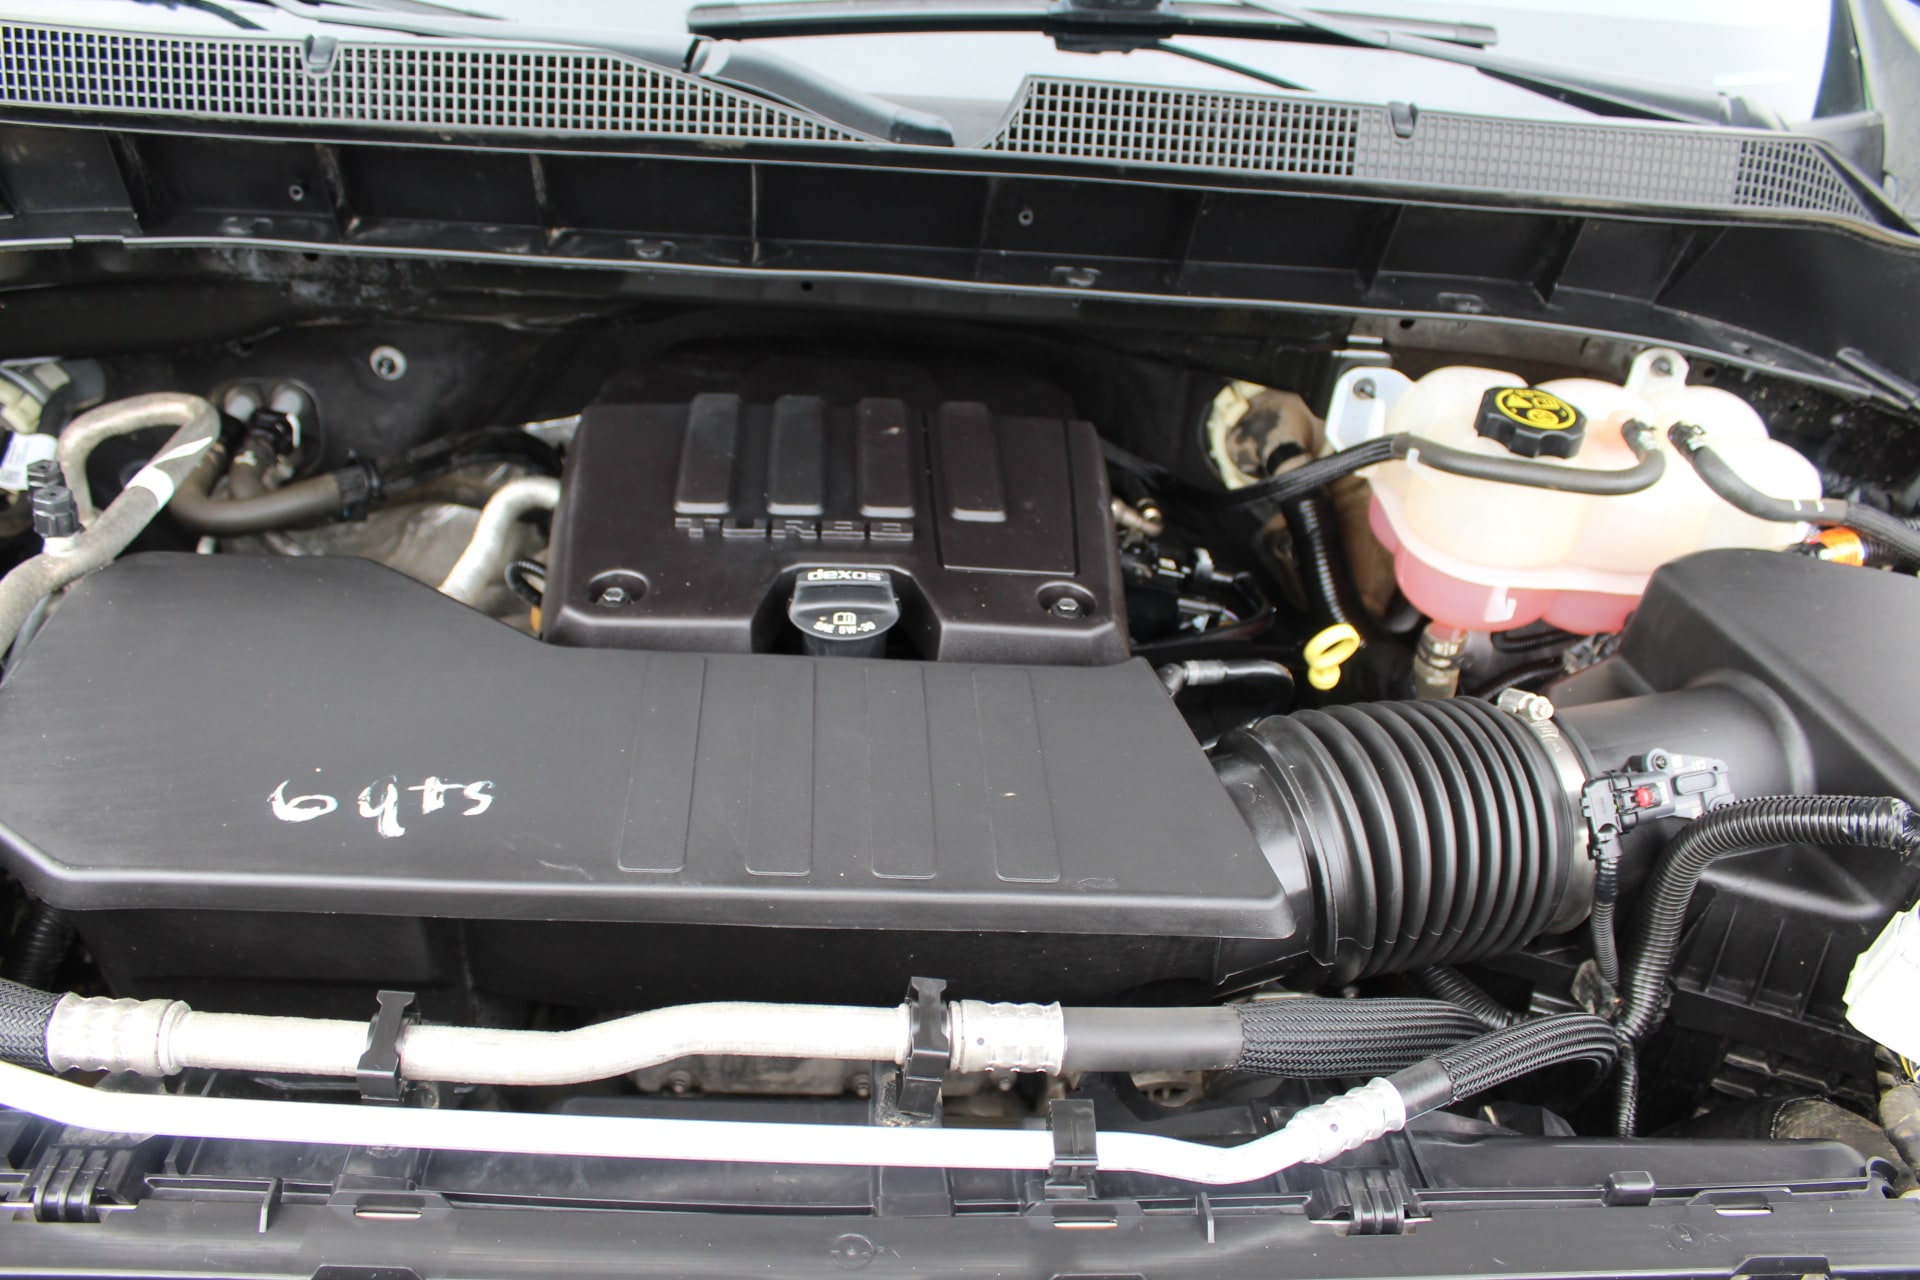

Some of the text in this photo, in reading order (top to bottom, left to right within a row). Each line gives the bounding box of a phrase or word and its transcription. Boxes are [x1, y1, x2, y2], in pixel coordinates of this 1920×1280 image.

[674, 516, 914, 542] TURBO
[807, 568, 882, 582] dexos
[266, 779, 338, 824] 6
